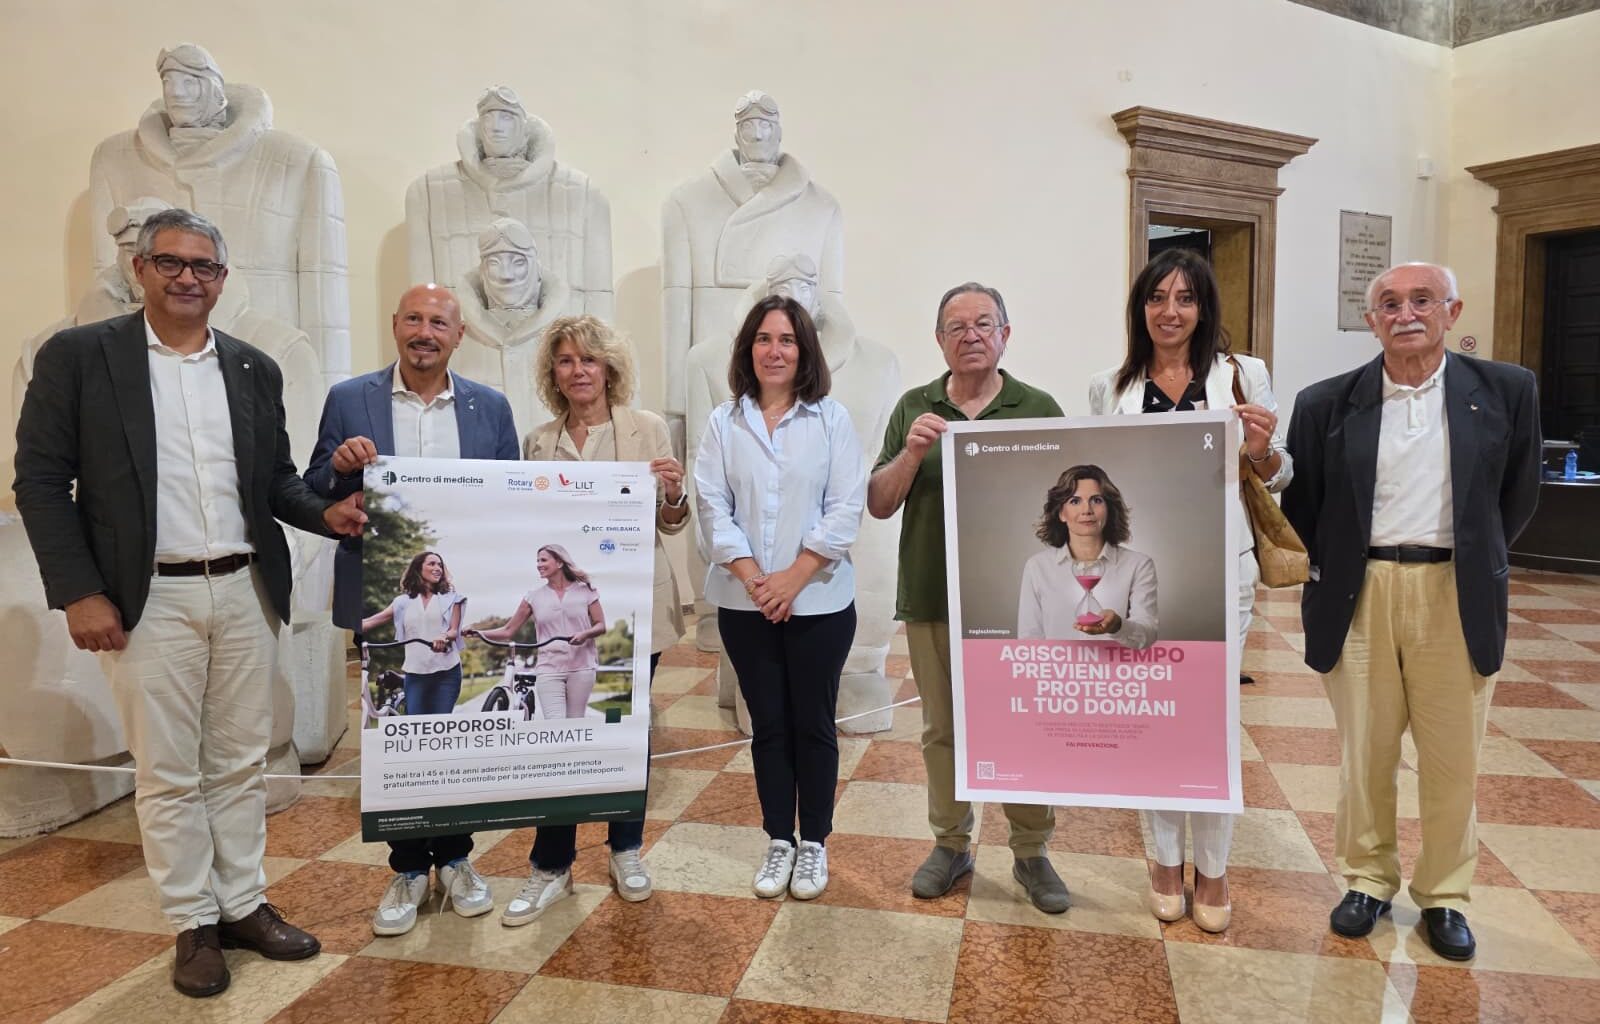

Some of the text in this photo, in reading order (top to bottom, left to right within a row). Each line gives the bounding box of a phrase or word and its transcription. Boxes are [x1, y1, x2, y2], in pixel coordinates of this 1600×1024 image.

[1021, 442, 1060, 451] medicina
[401, 475, 484, 484] Centro di medicina
[508, 478, 532, 487] Rotary
[576, 482, 595, 490] LILT
[1000, 646, 1184, 663] AGISCI IN TEMPO
[1012, 662, 1172, 680] PREVIENI OGGI
[1036, 680, 1147, 698] PROTEGGI
[1010, 697, 1176, 716] IL TUO DOMANI
[384, 718, 515, 736] OSTEOPOROSI:
[384, 728, 592, 754] PIÙ FORTI SE INFORMATE
[481, 765, 511, 773] aderisci
[573, 760, 602, 768] prenota
[384, 778, 439, 790] gratuitamente
[462, 775, 496, 783] controllo
[520, 771, 566, 780] prevenzione
